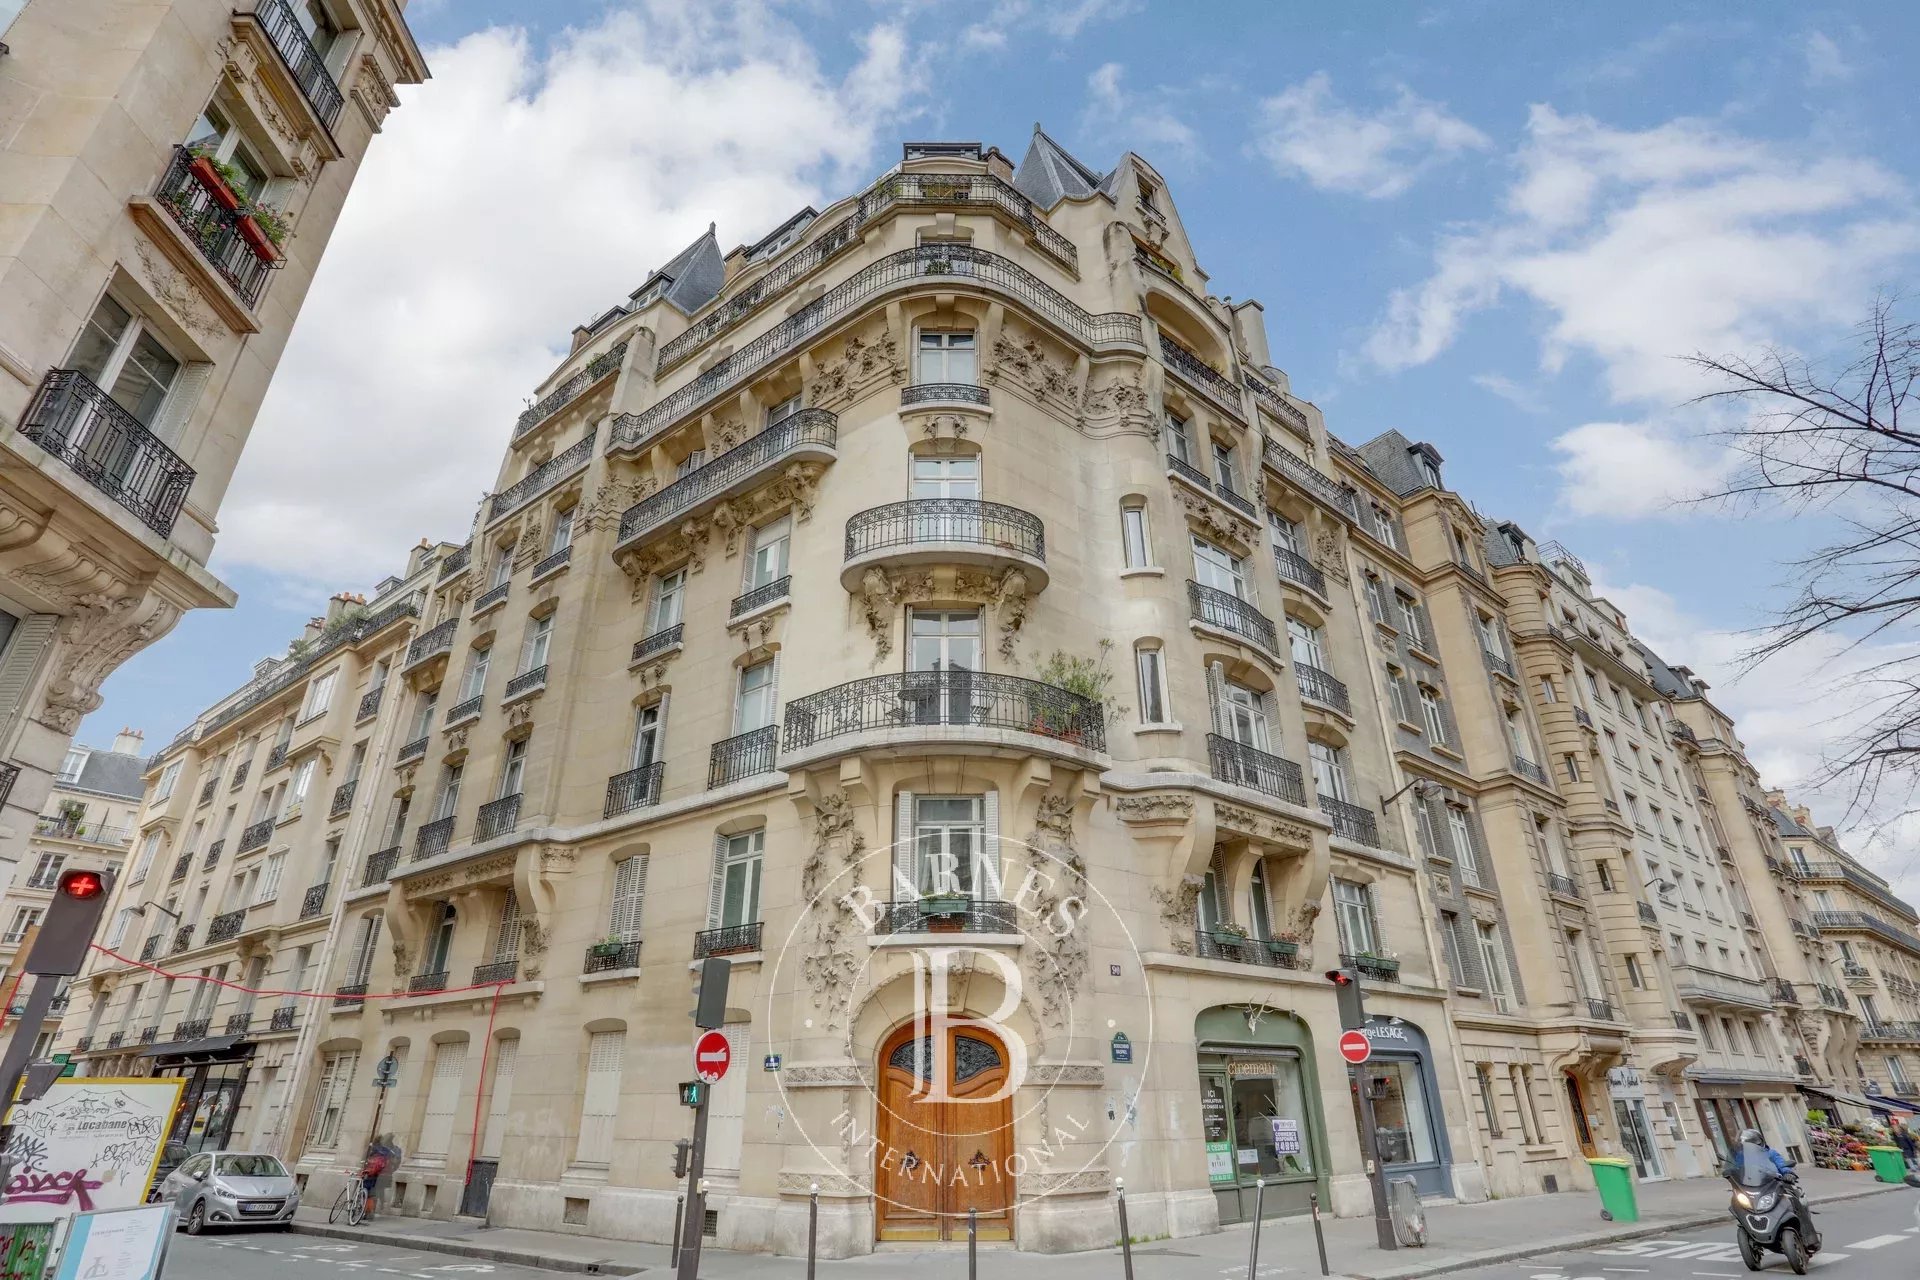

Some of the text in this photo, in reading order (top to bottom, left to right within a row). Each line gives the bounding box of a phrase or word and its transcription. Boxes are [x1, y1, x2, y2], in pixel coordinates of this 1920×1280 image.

[1360, 1026, 1404, 1040] erge LESAGE
[1207, 1089, 1216, 1098] ICI
[77, 1119, 128, 1131] Locabane
